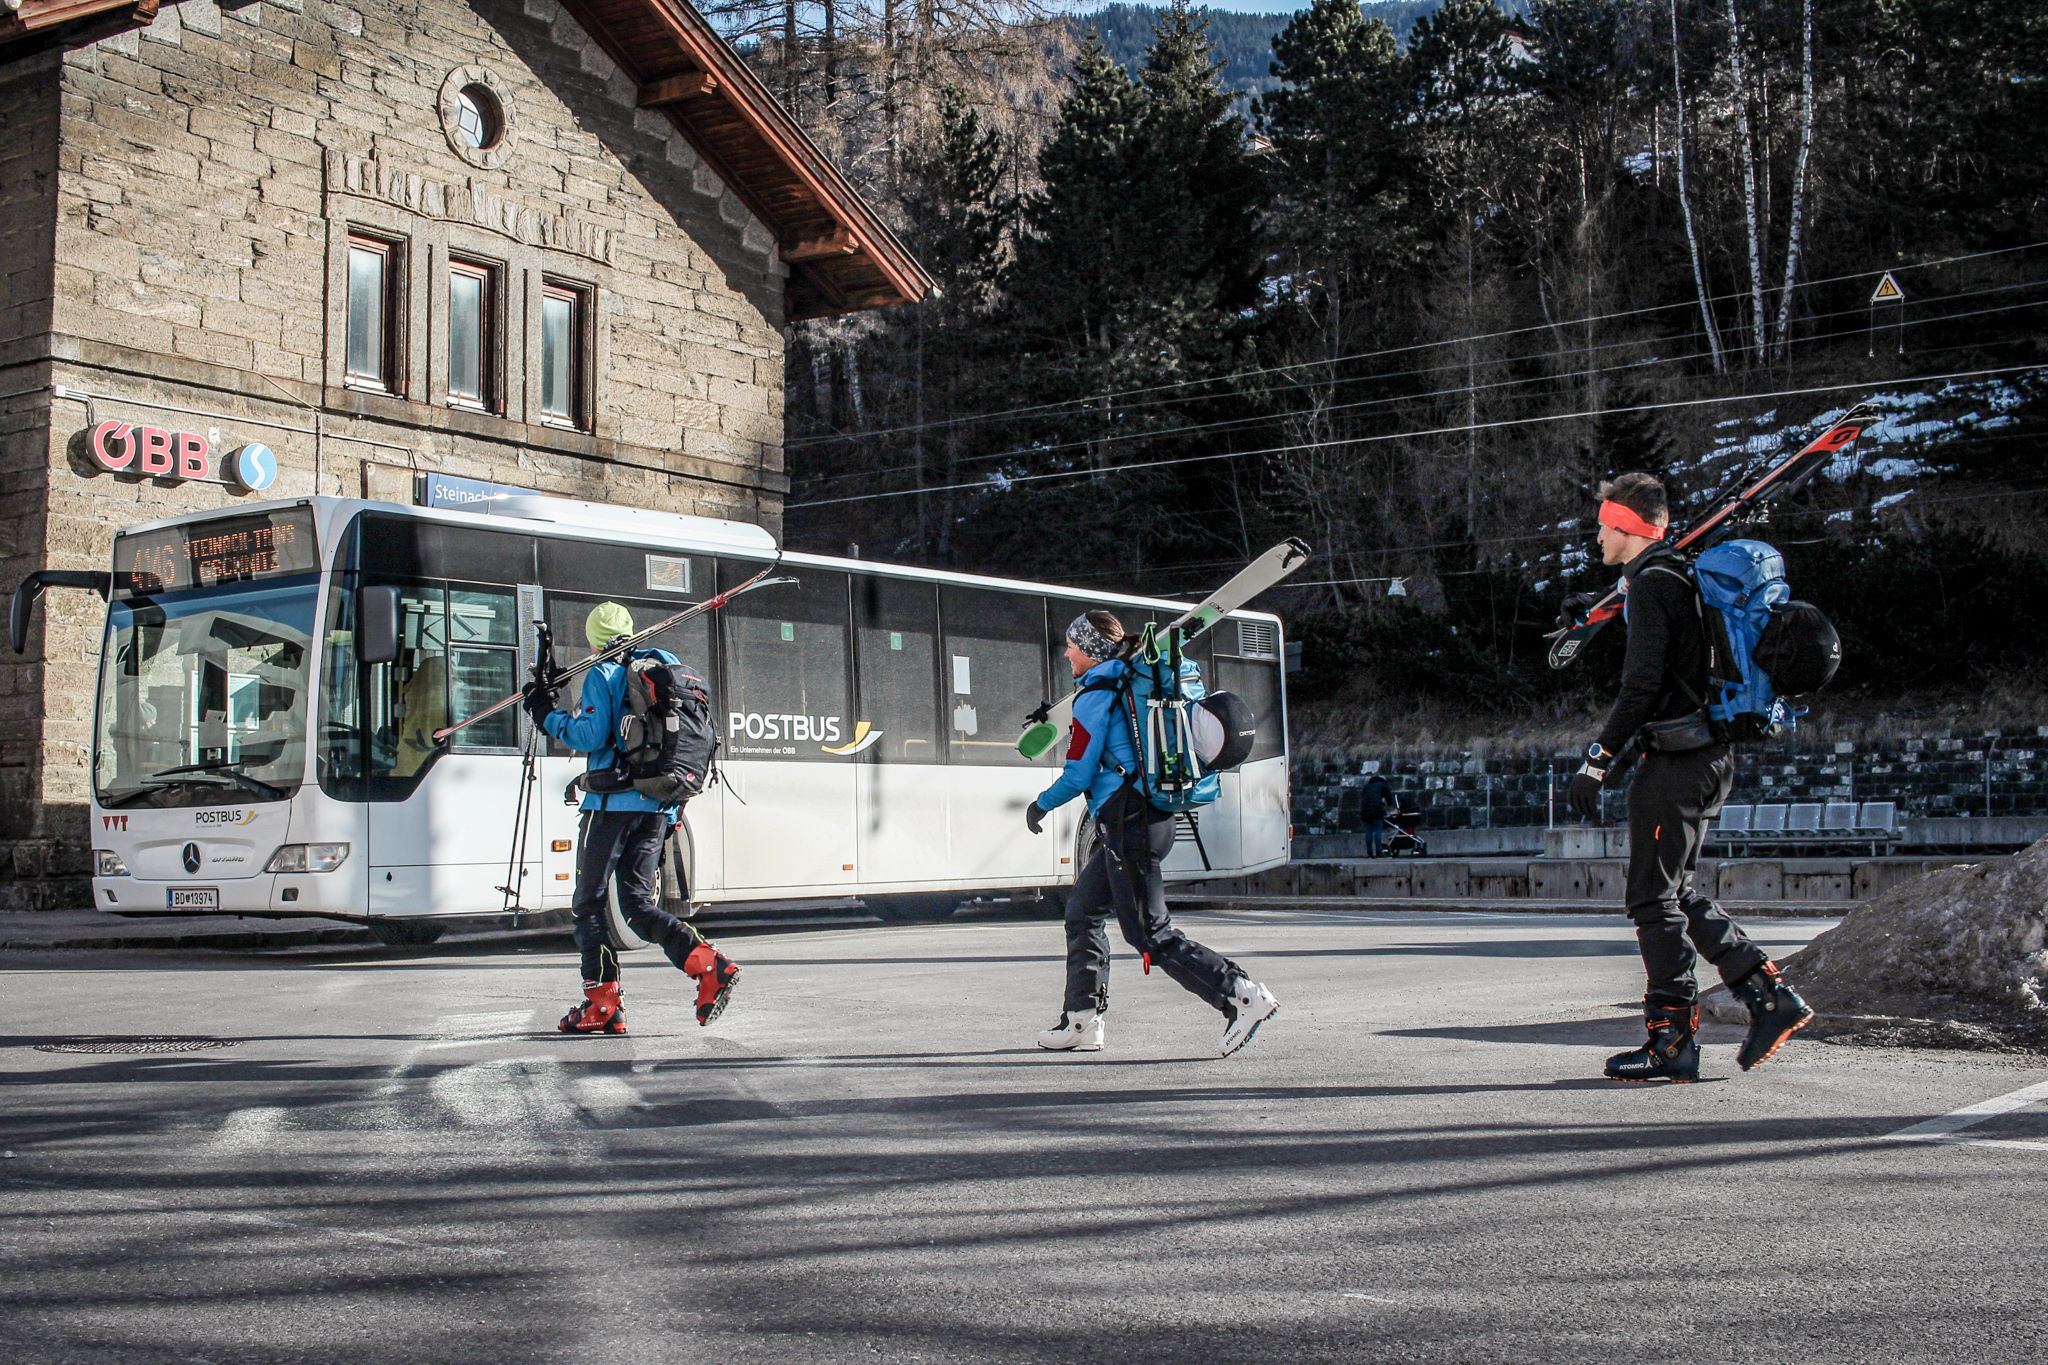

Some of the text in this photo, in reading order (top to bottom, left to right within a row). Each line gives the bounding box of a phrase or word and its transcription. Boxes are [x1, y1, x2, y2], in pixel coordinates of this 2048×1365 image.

[435, 484, 485, 502] Steinach
[729, 712, 841, 742] POSTBUS
[730, 745, 739, 753] Ein
[739, 746, 773, 754] Unternehmen
[195, 809, 242, 823] POSTBUS
[175, 892, 213, 905] BD 13974
[1619, 1062, 1645, 1070] ATOMIC
